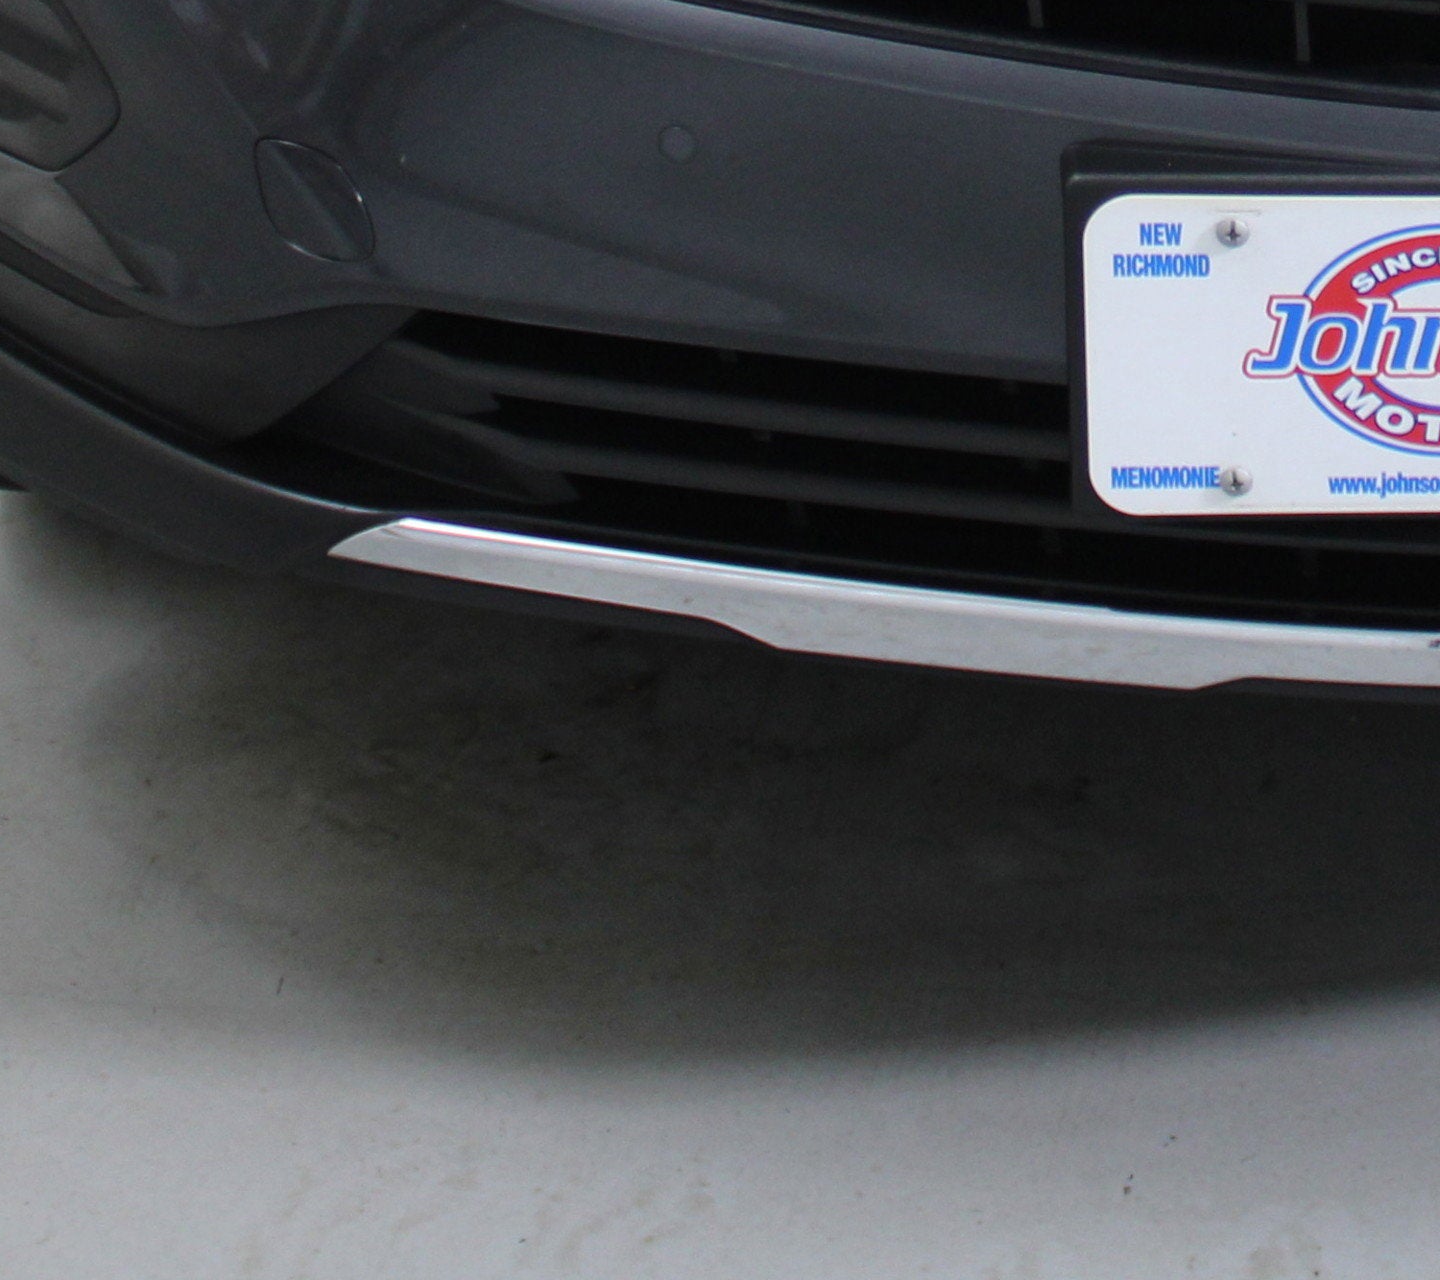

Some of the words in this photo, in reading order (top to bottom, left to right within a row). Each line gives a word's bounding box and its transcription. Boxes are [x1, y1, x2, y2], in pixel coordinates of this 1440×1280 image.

[1139, 222, 1183, 247] NEW
[1112, 253, 1211, 279] RICHMOND
[1110, 465, 1221, 490] MENOMONIE
